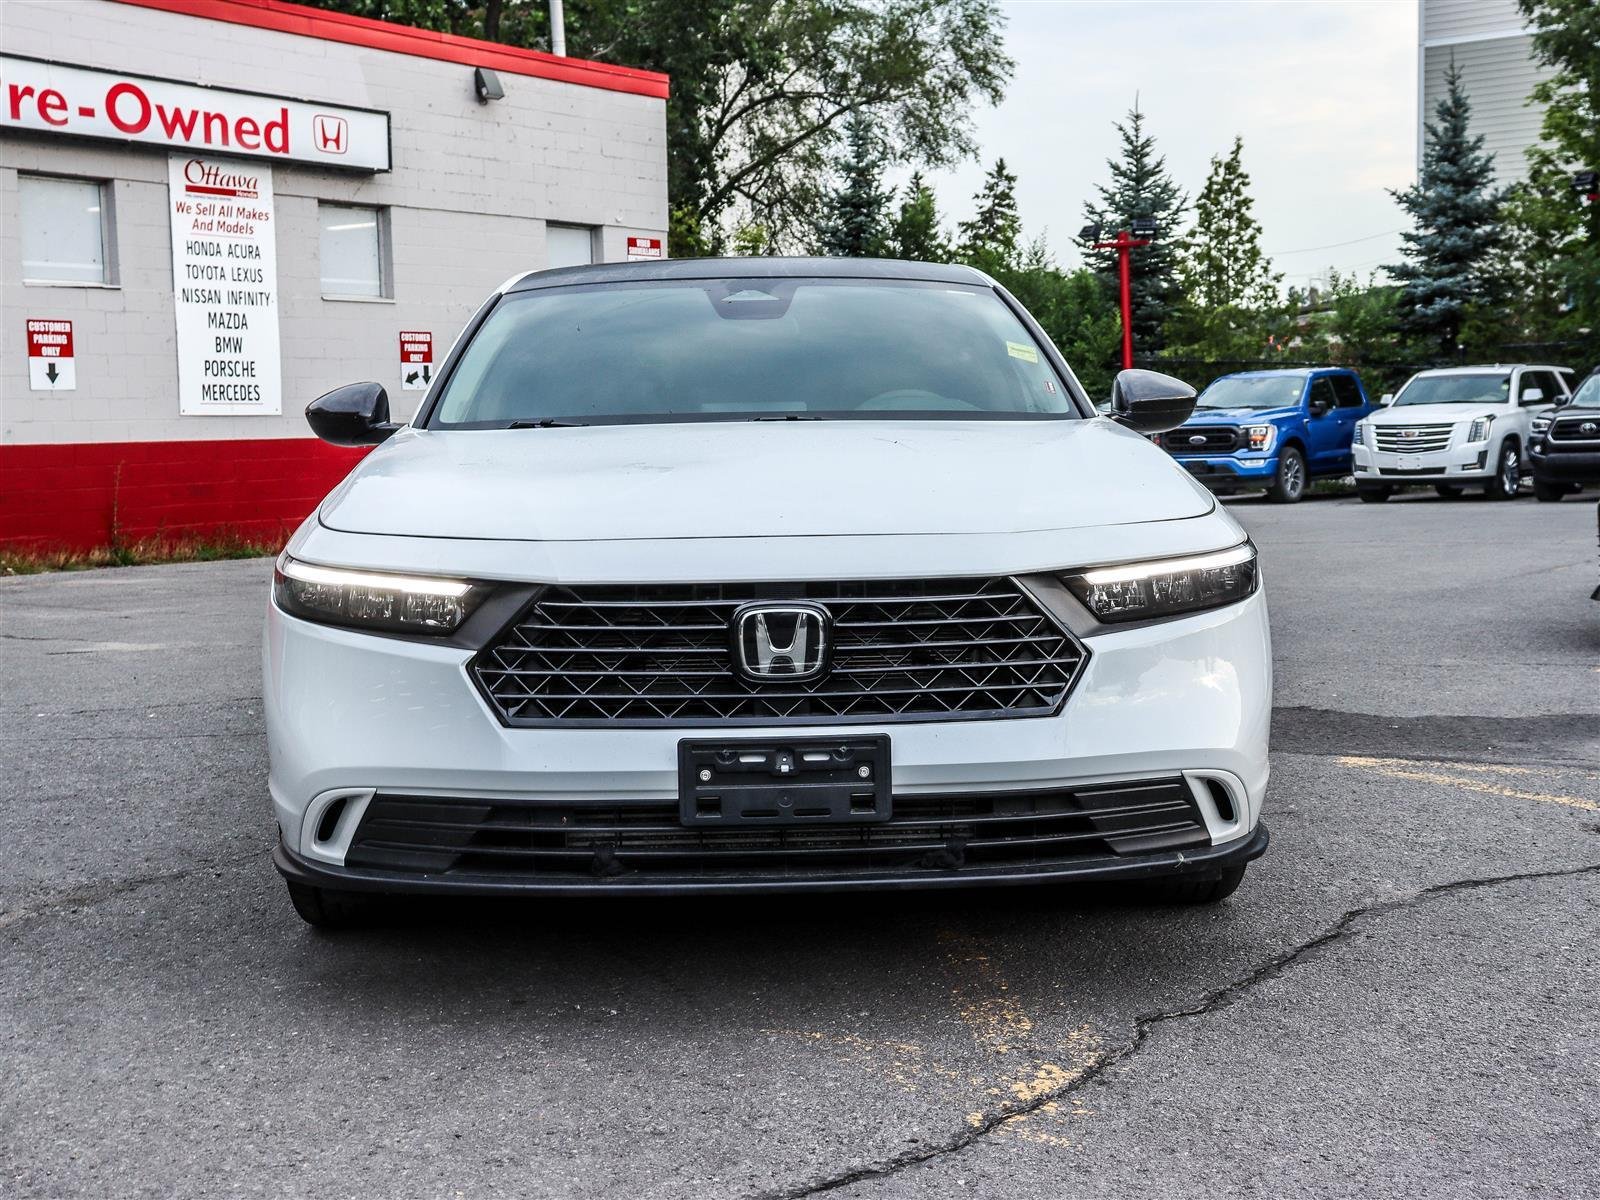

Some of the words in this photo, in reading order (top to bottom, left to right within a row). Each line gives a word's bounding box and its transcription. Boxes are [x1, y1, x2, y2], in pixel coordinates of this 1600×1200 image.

[0, 82, 290, 154] re-Owned
[184, 159, 258, 189] Ottawa
[235, 189, 259, 199] Honda
[176, 201, 192, 215] We
[196, 203, 216, 217] Sell
[218, 205, 233, 218] All
[236, 207, 270, 221] Makes
[192, 218, 214, 232] And
[217, 221, 255, 235] Models
[186, 240, 222, 257] HONDA
[227, 244, 261, 260] ACURA
[185, 264, 227, 281] TOYOTA
[231, 266, 264, 283] LEXUS
[182, 288, 221, 304] NISSAN
[227, 290, 270, 306] INFINITY
[28, 321, 71, 333] CUSTOMER
[208, 312, 248, 330] MAZDA
[33, 333, 68, 345] PARKING
[215, 336, 243, 353] BMW
[401, 332, 431, 342] CUSTOMER
[41, 346, 61, 357] ONLY
[404, 343, 429, 352] PARKING
[409, 353, 424, 362] ONLY
[204, 360, 256, 378] PORSCHE
[202, 384, 260, 401] MERCEDES
